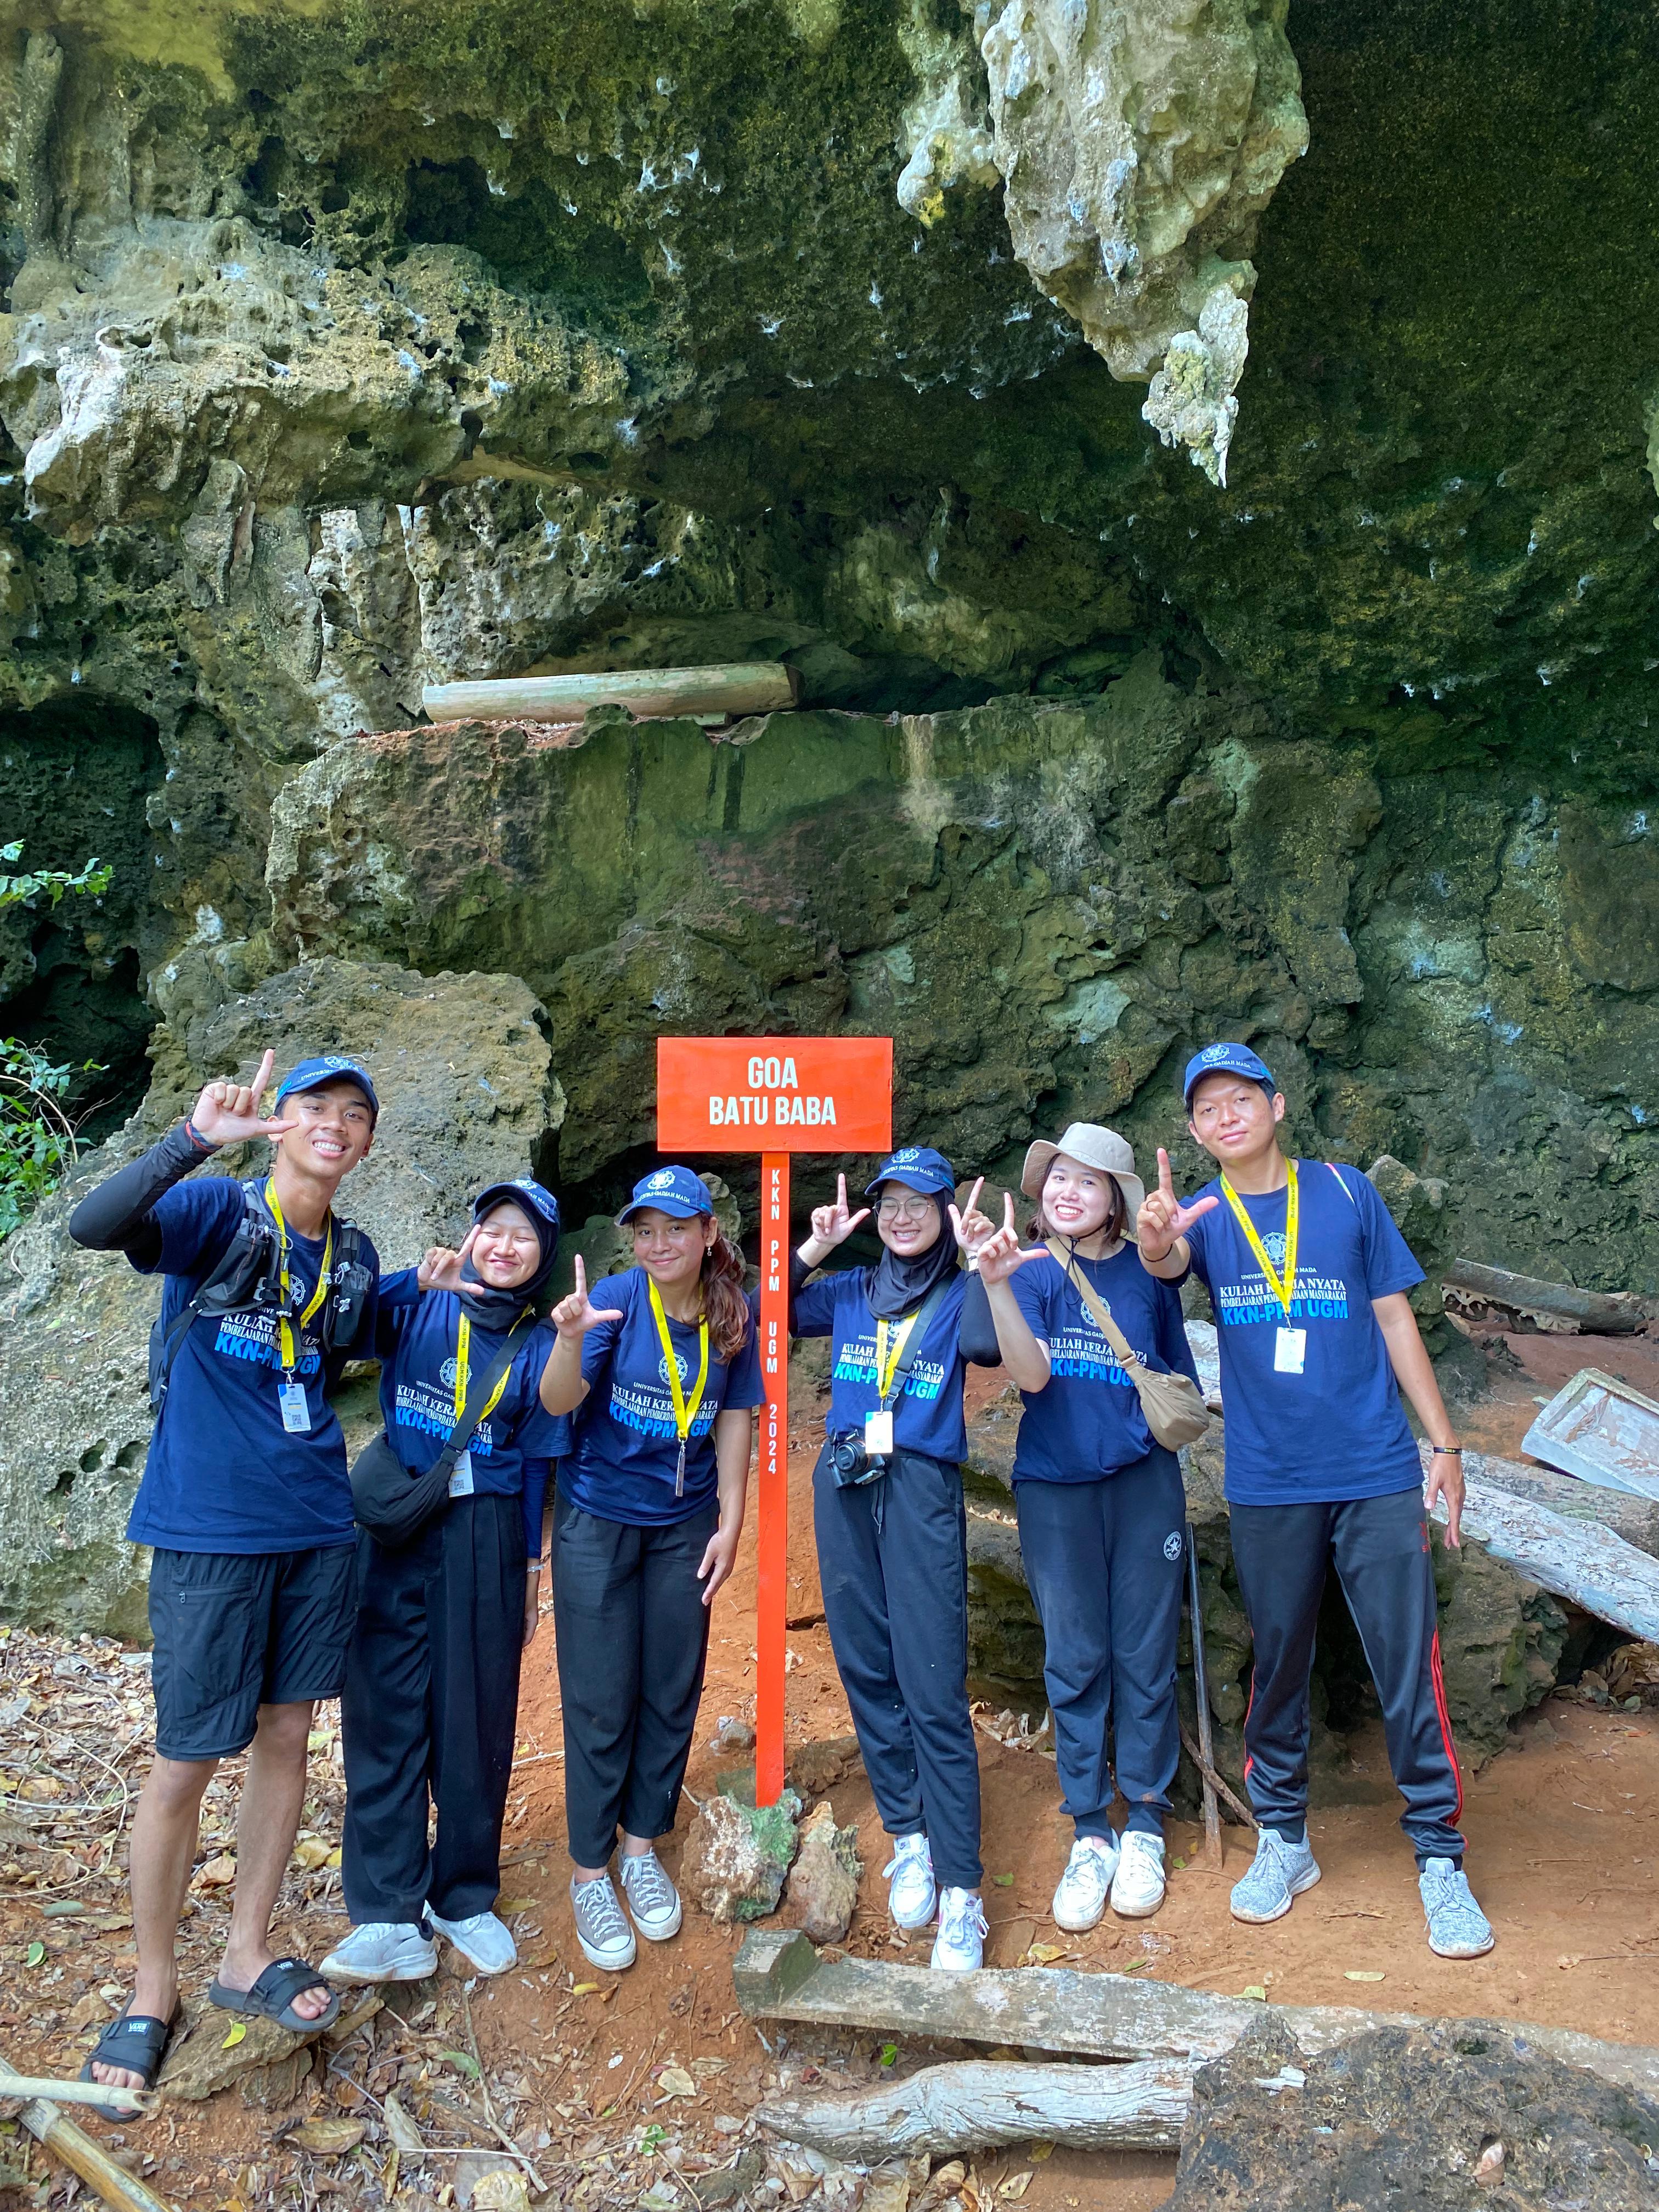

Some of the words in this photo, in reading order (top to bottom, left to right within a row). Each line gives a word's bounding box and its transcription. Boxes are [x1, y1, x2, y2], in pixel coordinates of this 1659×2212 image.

[748, 1057, 798, 1089] GOA
[709, 1096, 769, 1125] BATU
[775, 1096, 837, 1125] BABA
[771, 1169, 780, 1221] KKN
[769, 1240, 780, 1291] PPM
[1220, 1284, 1265, 1298] KULIAH
[1265, 1278, 1306, 1294] KJA
[1307, 1278, 1346, 1291] NYATA
[1220, 1295, 1264, 1308] PEMBELAJARAN
[1309, 1289, 1347, 1301] MASYARAKAT
[1221, 1299, 1304, 1325] KKN-PPM
[1307, 1299, 1349, 1319] UGM
[219, 1321, 271, 1344] PEMBELAJARAN
[766, 1321, 777, 1373] UGM
[1048, 1337, 1082, 1350] ULIAH
[1084, 1340, 1114, 1357] KERJA
[1091, 1331, 1105, 1340] GADJ
[841, 1343, 874, 1358] KULIAH
[1050, 1348, 1080, 1359] BELAJARAN
[833, 1362, 879, 1386] KKN-P
[904, 1377, 940, 1400] UGM
[1051, 1358, 1108, 1381] KN-PPM
[1109, 1366, 1134, 1387] UG
[443, 1392, 455, 1402] GADJ
[612, 1382, 652, 1407] KULIAH
[651, 1397, 675, 1412] KER
[698, 1400, 718, 1410] ATA
[633, 1381, 665, 1395] UNIVERSITAS
[397, 1384, 430, 1407] KULIAH
[429, 1397, 457, 1417] KERJ
[475, 1421, 493, 1435] ATA
[609, 1401, 678, 1438] KKN-PPM
[690, 1419, 714, 1437] GM
[611, 1392, 647, 1417] PEMBELAJARAN
[646, 1407, 677, 1421] PEMBERDAY
[695, 1409, 718, 1420] YARAKAT
[396, 1406, 454, 1442] KKN-PPM
[467, 1435, 493, 1457] GM
[768, 1403, 777, 1474] 2024
[129, 2022, 148, 2030] VANS
